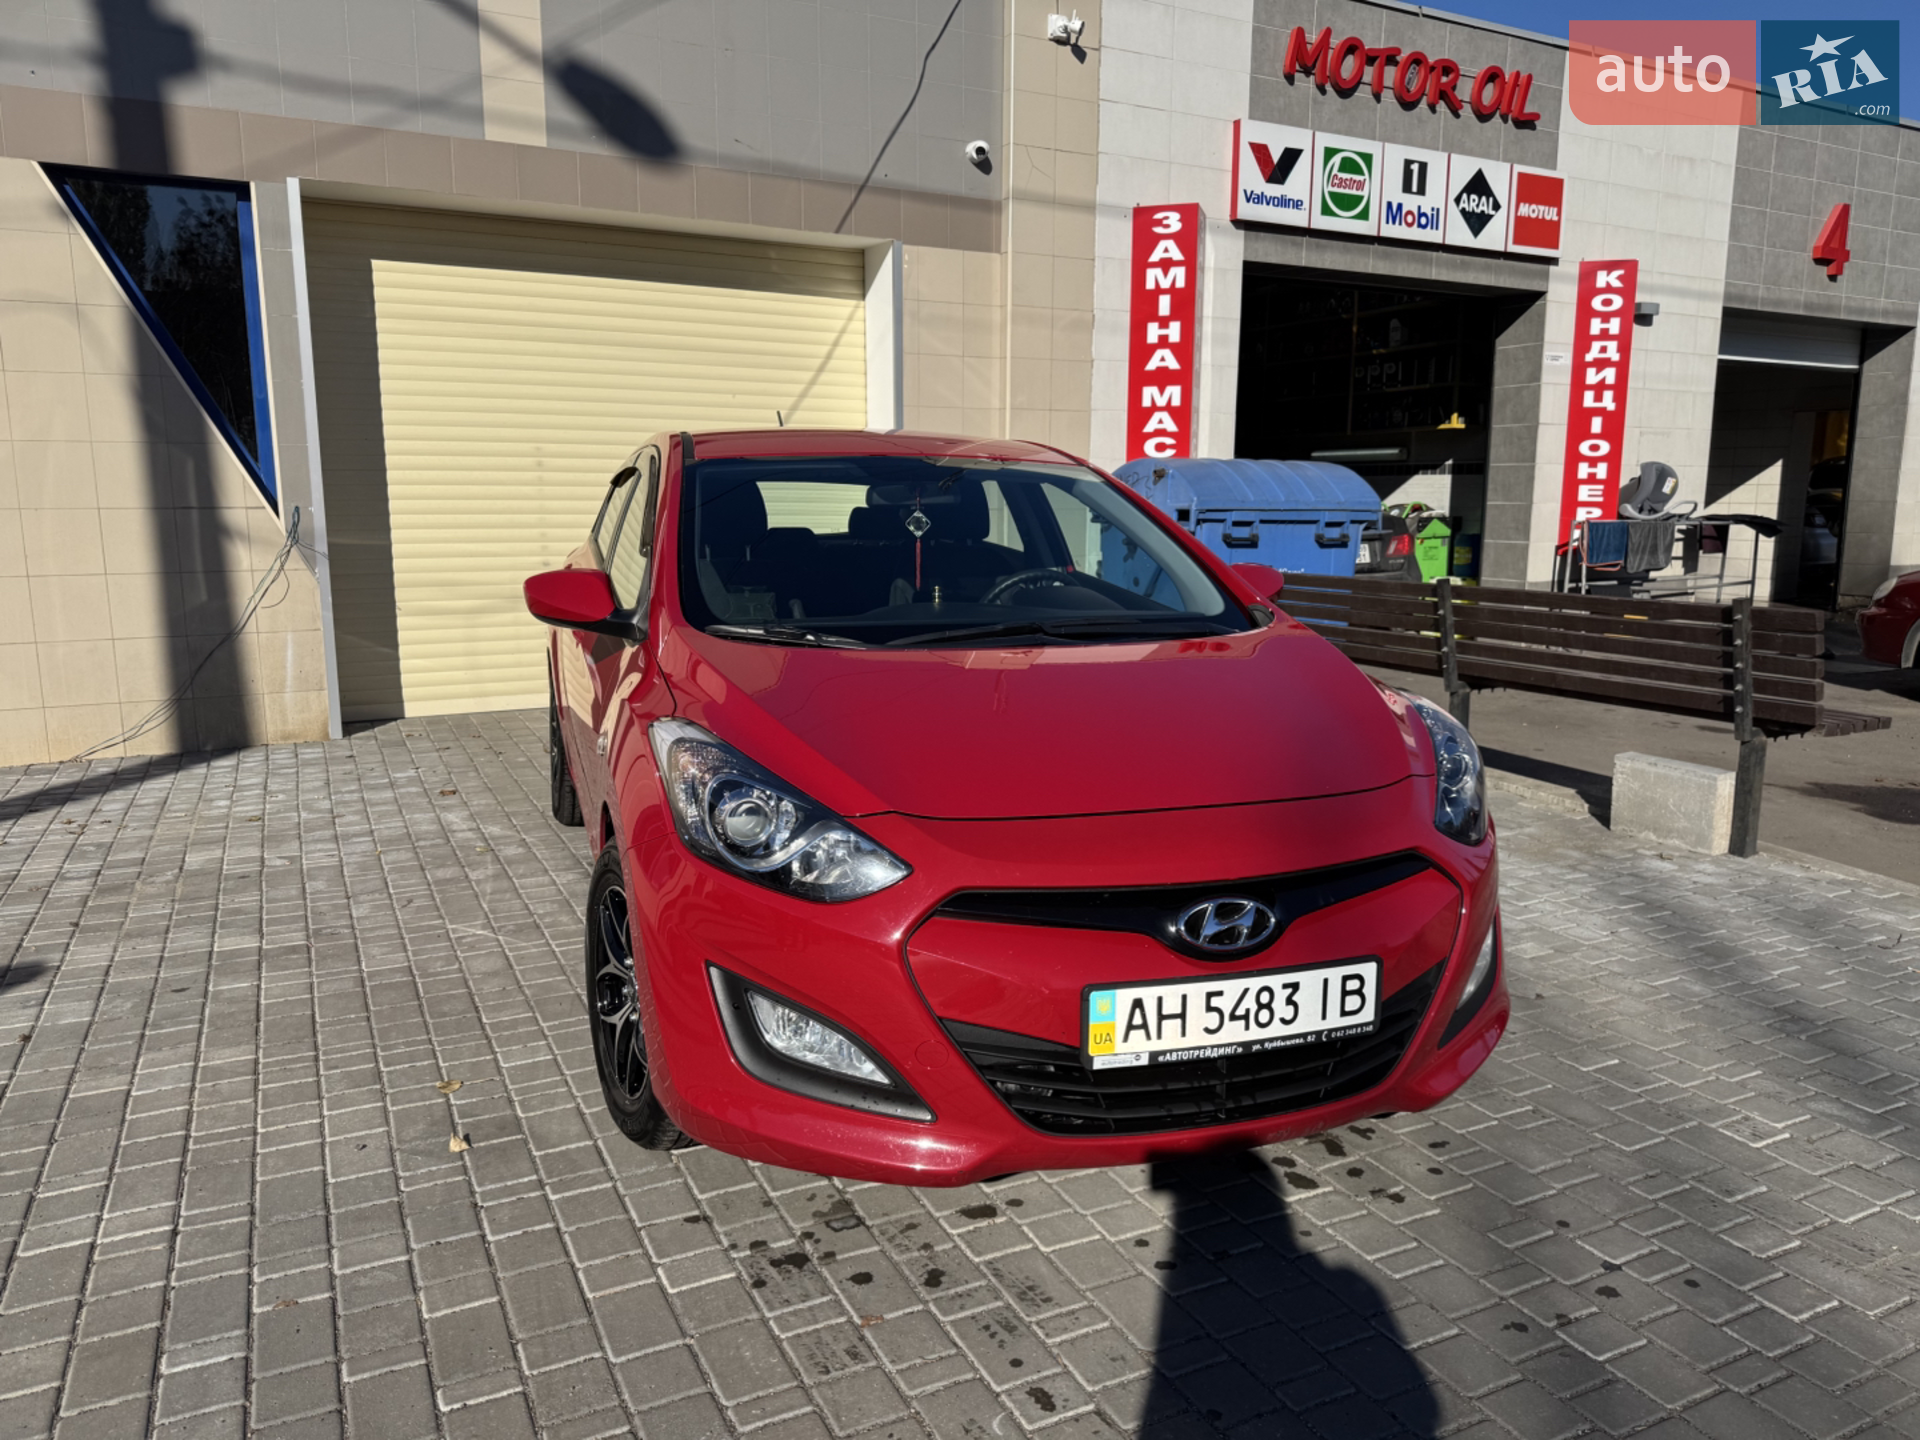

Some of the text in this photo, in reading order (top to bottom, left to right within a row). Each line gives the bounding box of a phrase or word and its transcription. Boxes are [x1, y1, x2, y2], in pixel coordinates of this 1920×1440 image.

[1283, 25, 1541, 122] MOTOR OIL
[1330, 173, 1367, 193] Castrol
[1408, 162, 1420, 193] 1
[1243, 188, 1304, 210] Valvoline
[1457, 192, 1497, 216] ARAL
[1517, 202, 1559, 221] MOTUL
[1384, 200, 1440, 231] Mobil
[1811, 202, 1851, 276] 4
[1144, 211, 1186, 372] ЗАМІНА
[1121, 972, 1367, 1044] AH 5483 IB
[1093, 1032, 1113, 1045] UA
[1157, 1045, 1243, 1062] «АВТОТРЕЙДИНГ»
